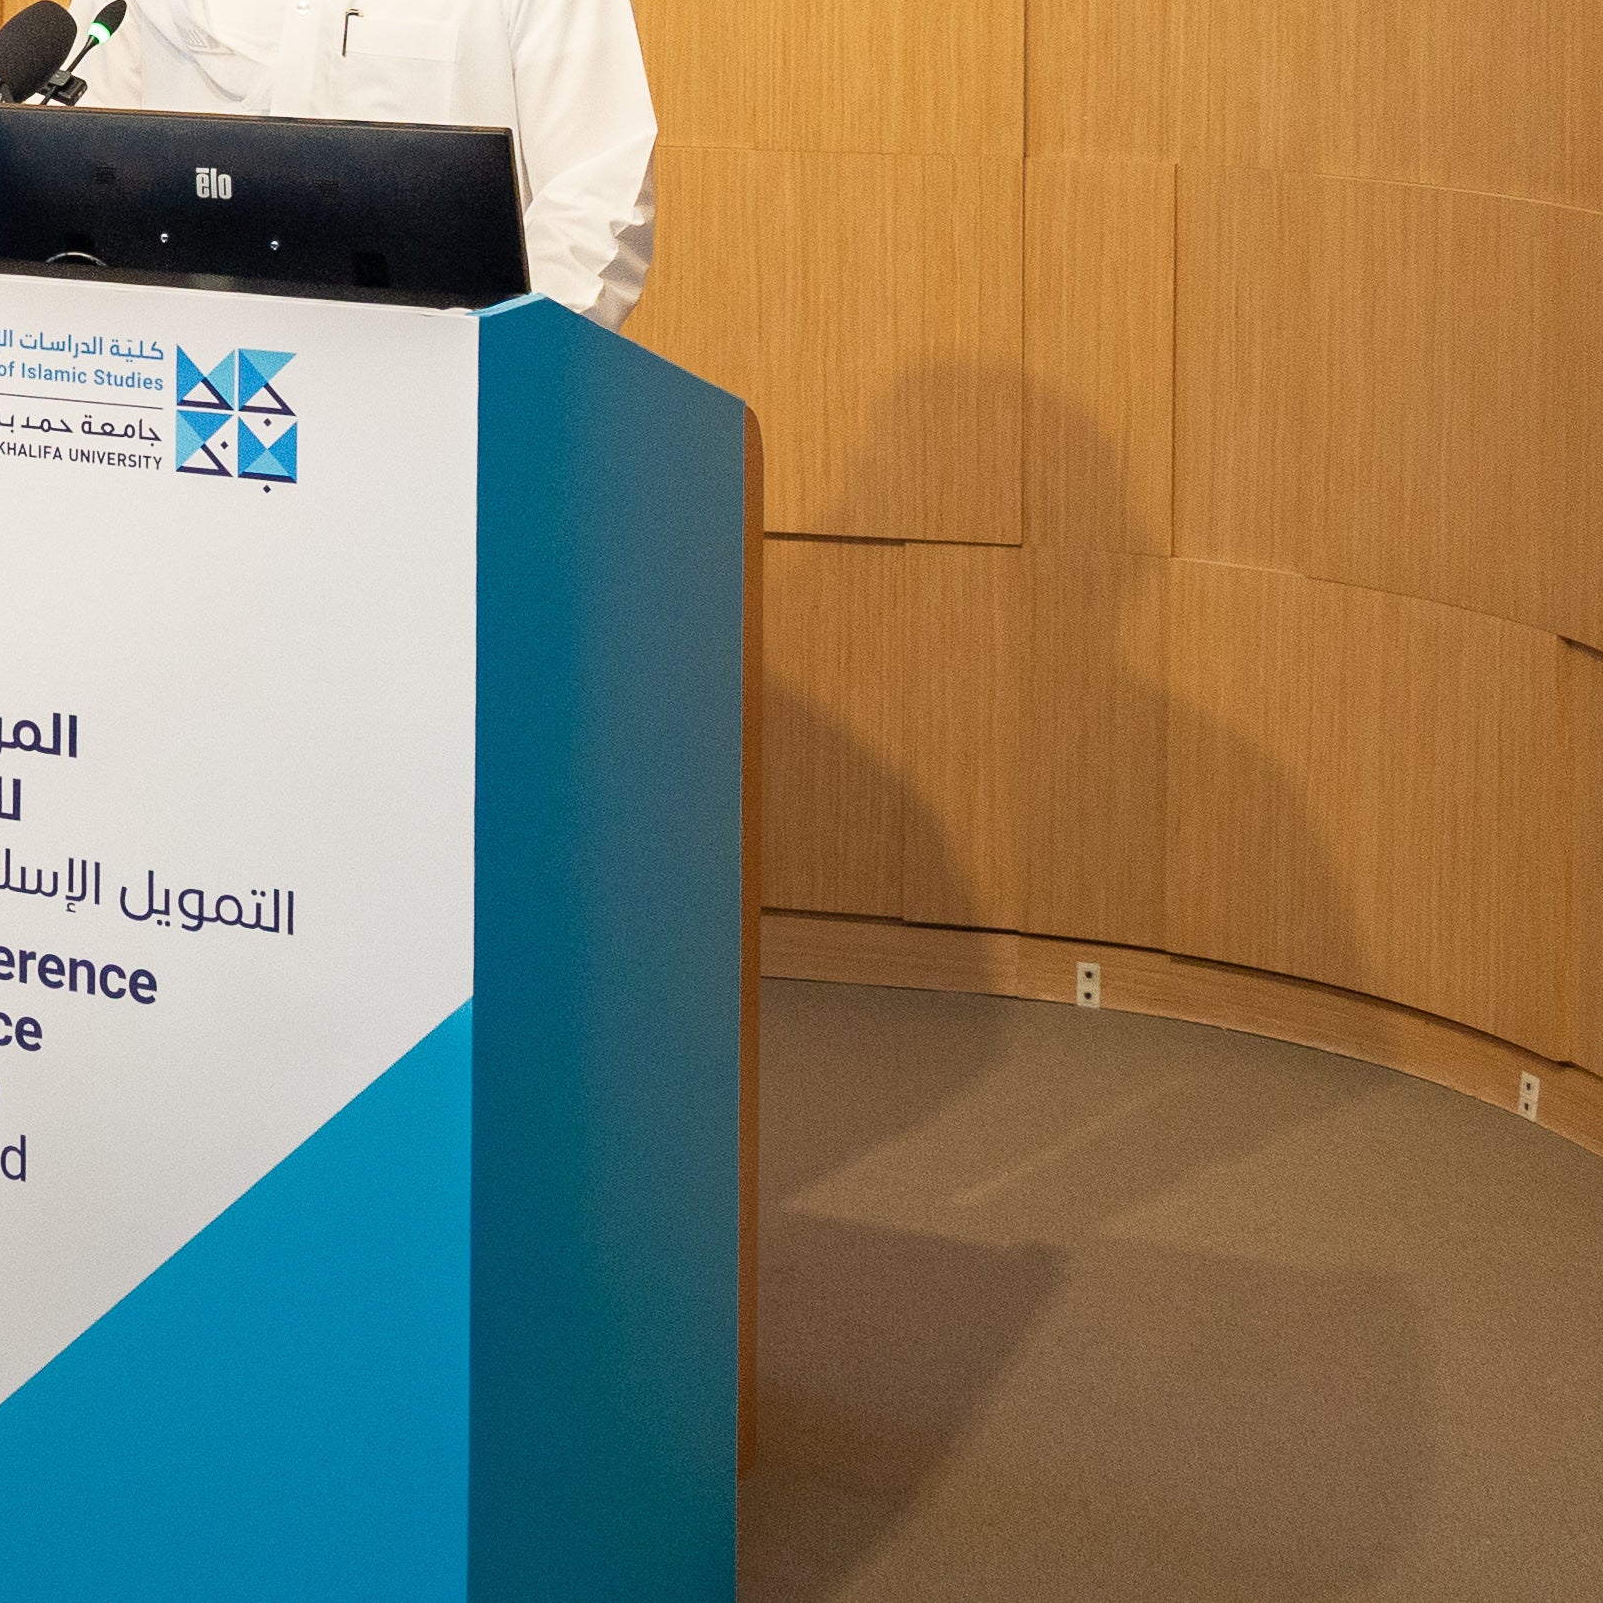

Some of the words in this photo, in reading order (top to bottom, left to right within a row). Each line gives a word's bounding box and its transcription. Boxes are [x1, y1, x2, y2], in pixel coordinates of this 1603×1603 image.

[19, 332, 103, 358] الدراسات
[22, 363, 86, 383] Islamic
[94, 369, 163, 390] Studies
[21, 417, 73, 433] حمد
[81, 415, 162, 446] جامعة
[69, 443, 162, 470] UNIVERSITY
[120, 870, 294, 935] التمويل
